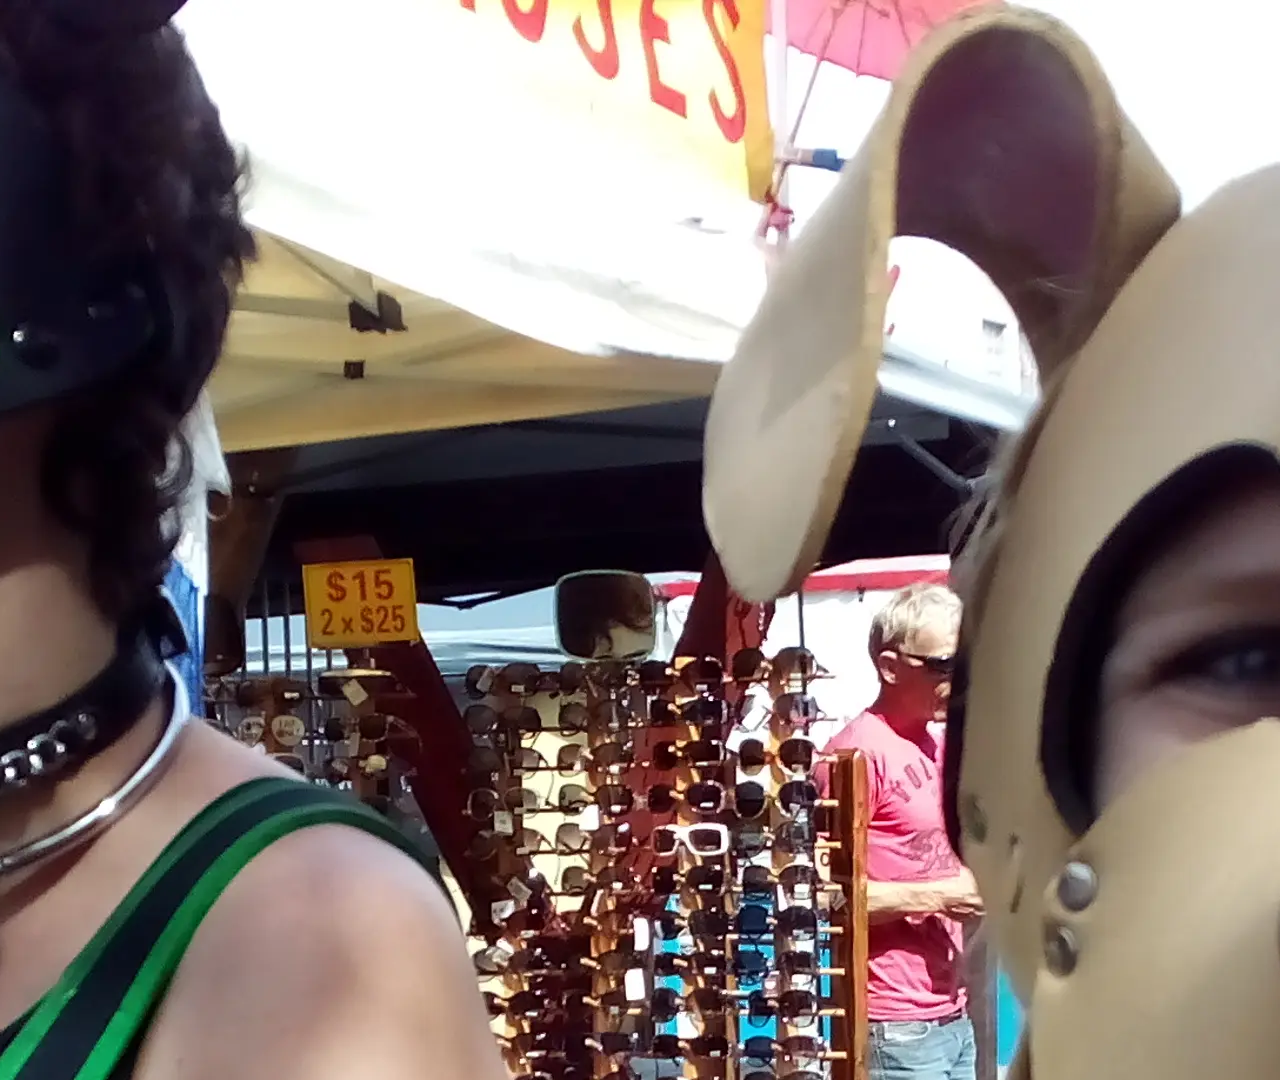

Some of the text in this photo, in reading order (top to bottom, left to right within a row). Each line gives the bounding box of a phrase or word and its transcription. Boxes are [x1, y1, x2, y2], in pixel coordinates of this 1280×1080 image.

[326, 569, 394, 602] $15
[320, 605, 405, 636] 2 x $25
